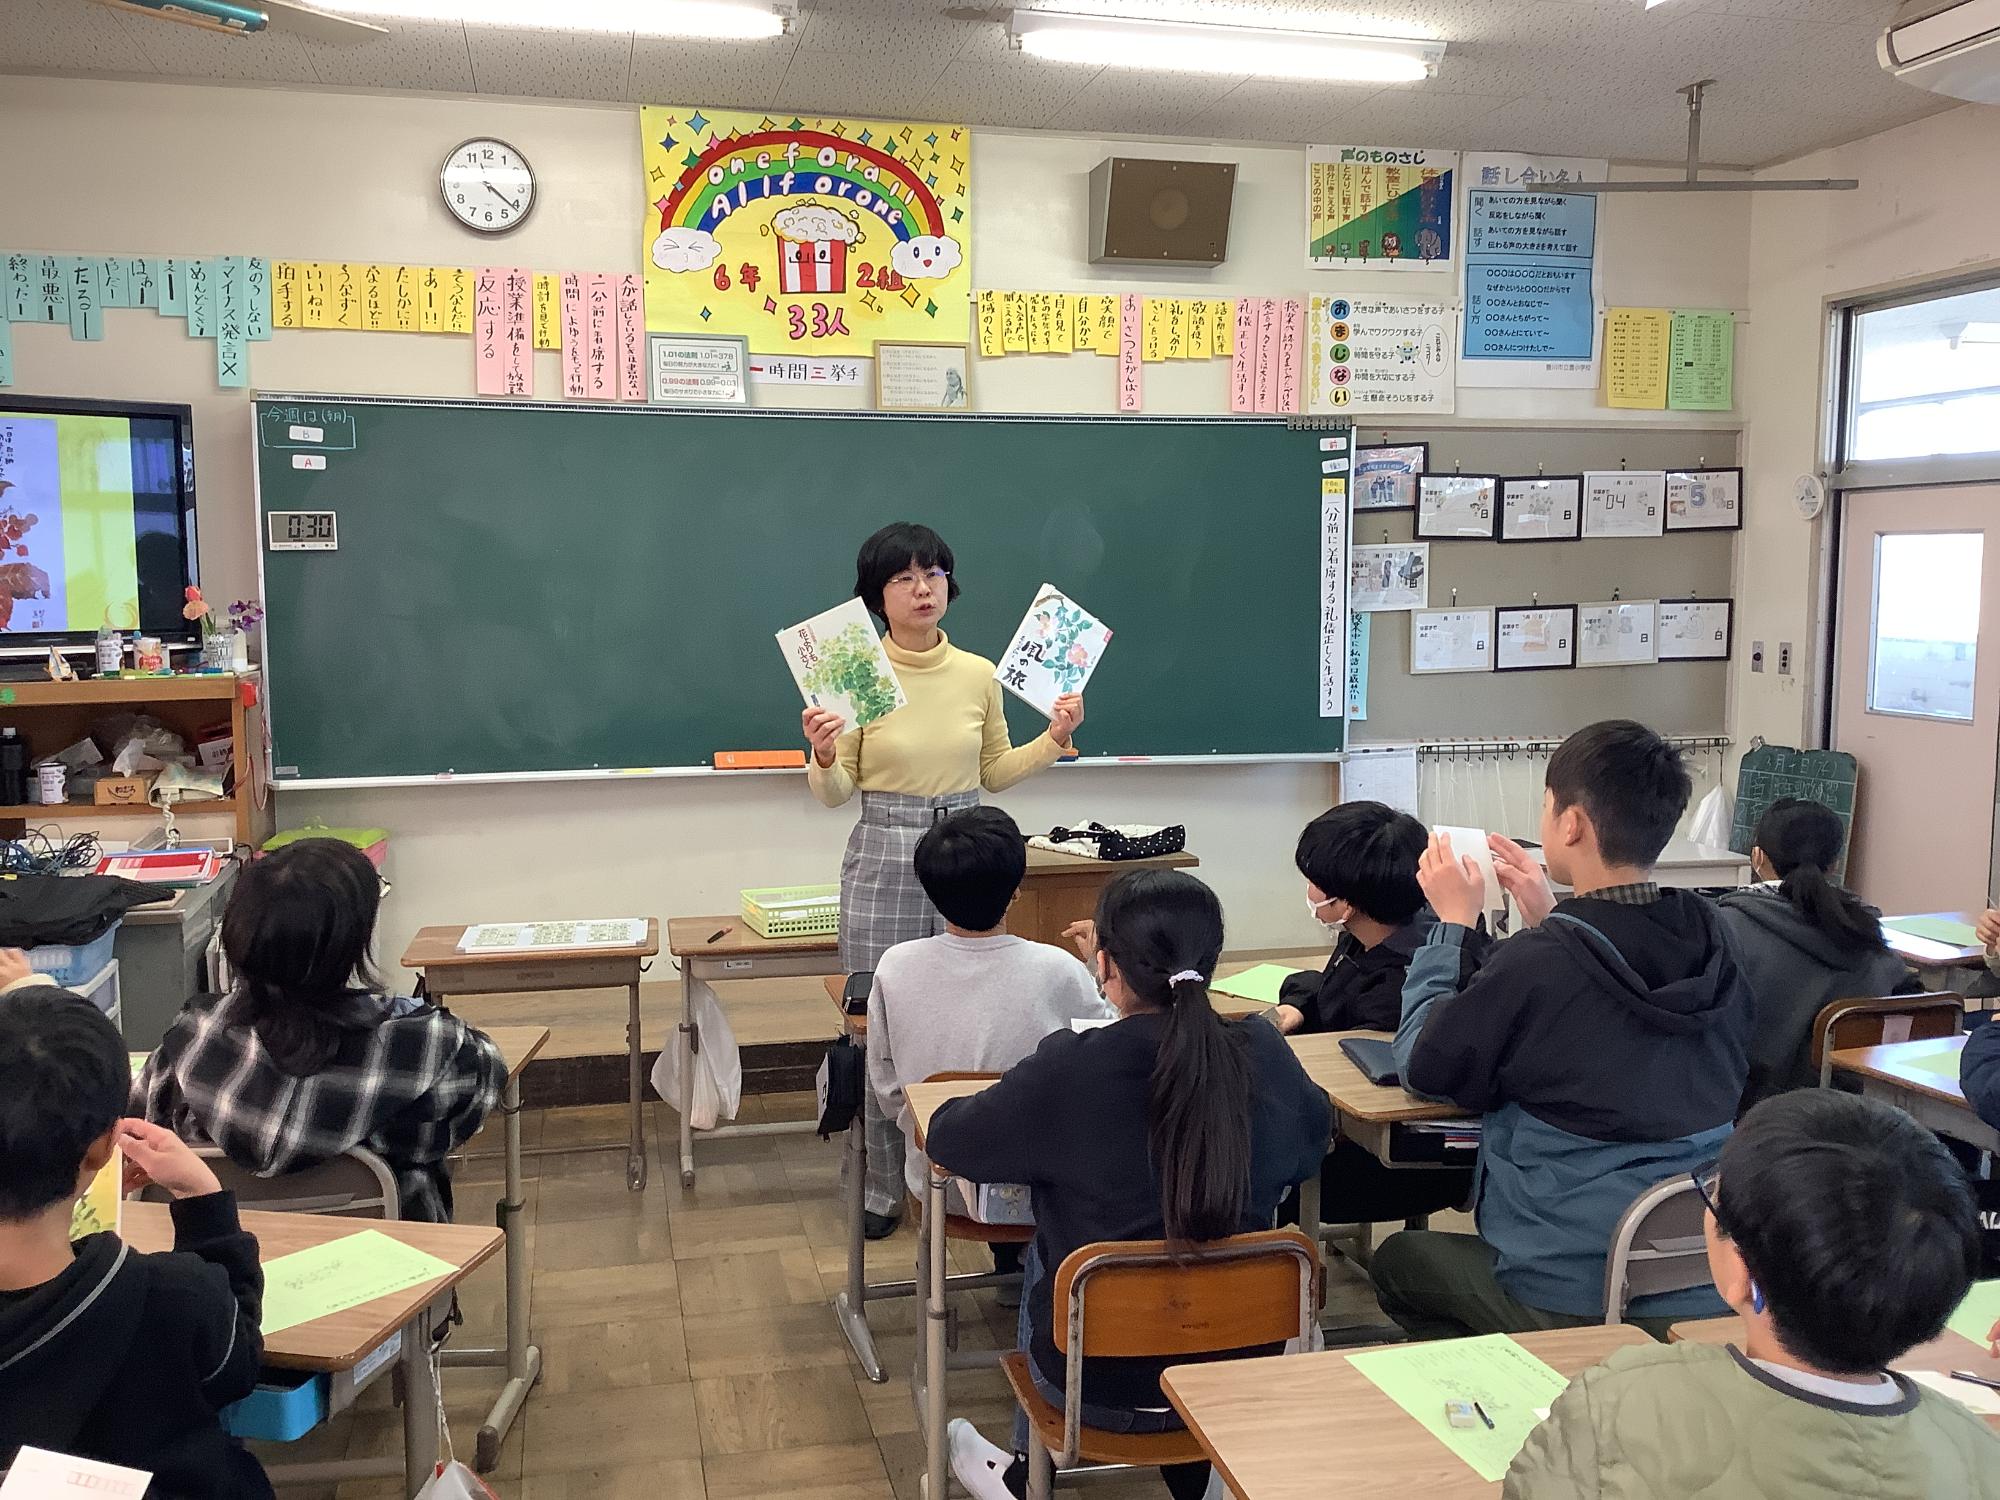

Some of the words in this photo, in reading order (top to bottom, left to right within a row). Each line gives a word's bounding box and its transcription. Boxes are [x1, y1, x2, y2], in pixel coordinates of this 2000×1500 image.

[467, 153, 477, 163] 11
[482, 149, 494, 160] 12
[501, 155, 507, 165] 1
[1341, 148, 1425, 164] 声のものさし
[1312, 164, 1322, 222] こころの中の声
[1327, 165, 1336, 221] 自分にきこえる声
[1342, 164, 1352, 222] となりに話す声
[1360, 166, 1372, 221] はんで話す
[457, 194, 465, 204] 8
[512, 199, 520, 209] 4
[1488, 197, 1567, 206] あいての方を見ながら聞く
[469, 207, 477, 217] 7
[1475, 197, 1484, 217] 聞く
[485, 212, 493, 222] 6
[501, 209, 509, 219] 5
[1488, 212, 1546, 220] 反応をしながら聞く
[1488, 227, 1568, 237] あいての方を見ながら話す
[1473, 228, 1483, 248] 話す
[1487, 241, 1578, 252] 伝わる声の大きさを考えて話す
[713, 262, 761, 292] 6年
[857, 262, 906, 291] 2組
[278, 264, 296, 326] 拍手する
[338, 268, 357, 326] うなずく
[1334, 302, 1347, 317] お
[1353, 305, 1445, 315] 大きな声であいさつをする子
[1471, 295, 1481, 325] 話し方
[477, 275, 500, 358] 反応する
[788, 303, 850, 339] 33人
[1078, 297, 1091, 346] 自分から
[1098, 297, 1115, 340] 笑顔で
[591, 282, 607, 390] 一分前に着席する
[1334, 325, 1346, 338] ま
[1353, 328, 1423, 337] 学んでワクワクする子
[1124, 296, 1138, 407] あいさつをがんばる
[1335, 347, 1346, 361] じ
[1353, 351, 1396, 360] 時間を守る子
[750, 363, 859, 381] 一時間三挙手
[1334, 369, 1347, 382] な
[1354, 373, 1416, 382] 仲間を大切にする子
[1334, 391, 1347, 403] い
[1354, 394, 1435, 402] 一生懸命そうじをする子
[304, 458, 312, 468] A
[1726, 500, 1734, 510] 日
[1480, 509, 1488, 519] 日
[1564, 510, 1571, 520] 日
[1648, 507, 1655, 516] 日
[288, 514, 332, 538] 0:30
[1409, 579, 1417, 588] 日
[1640, 633, 1648, 643] 日
[1714, 631, 1723, 641] 日
[1476, 640, 1485, 650] 日
[1558, 639, 1566, 648] 日
[1002, 640, 1044, 691] 風の旅
